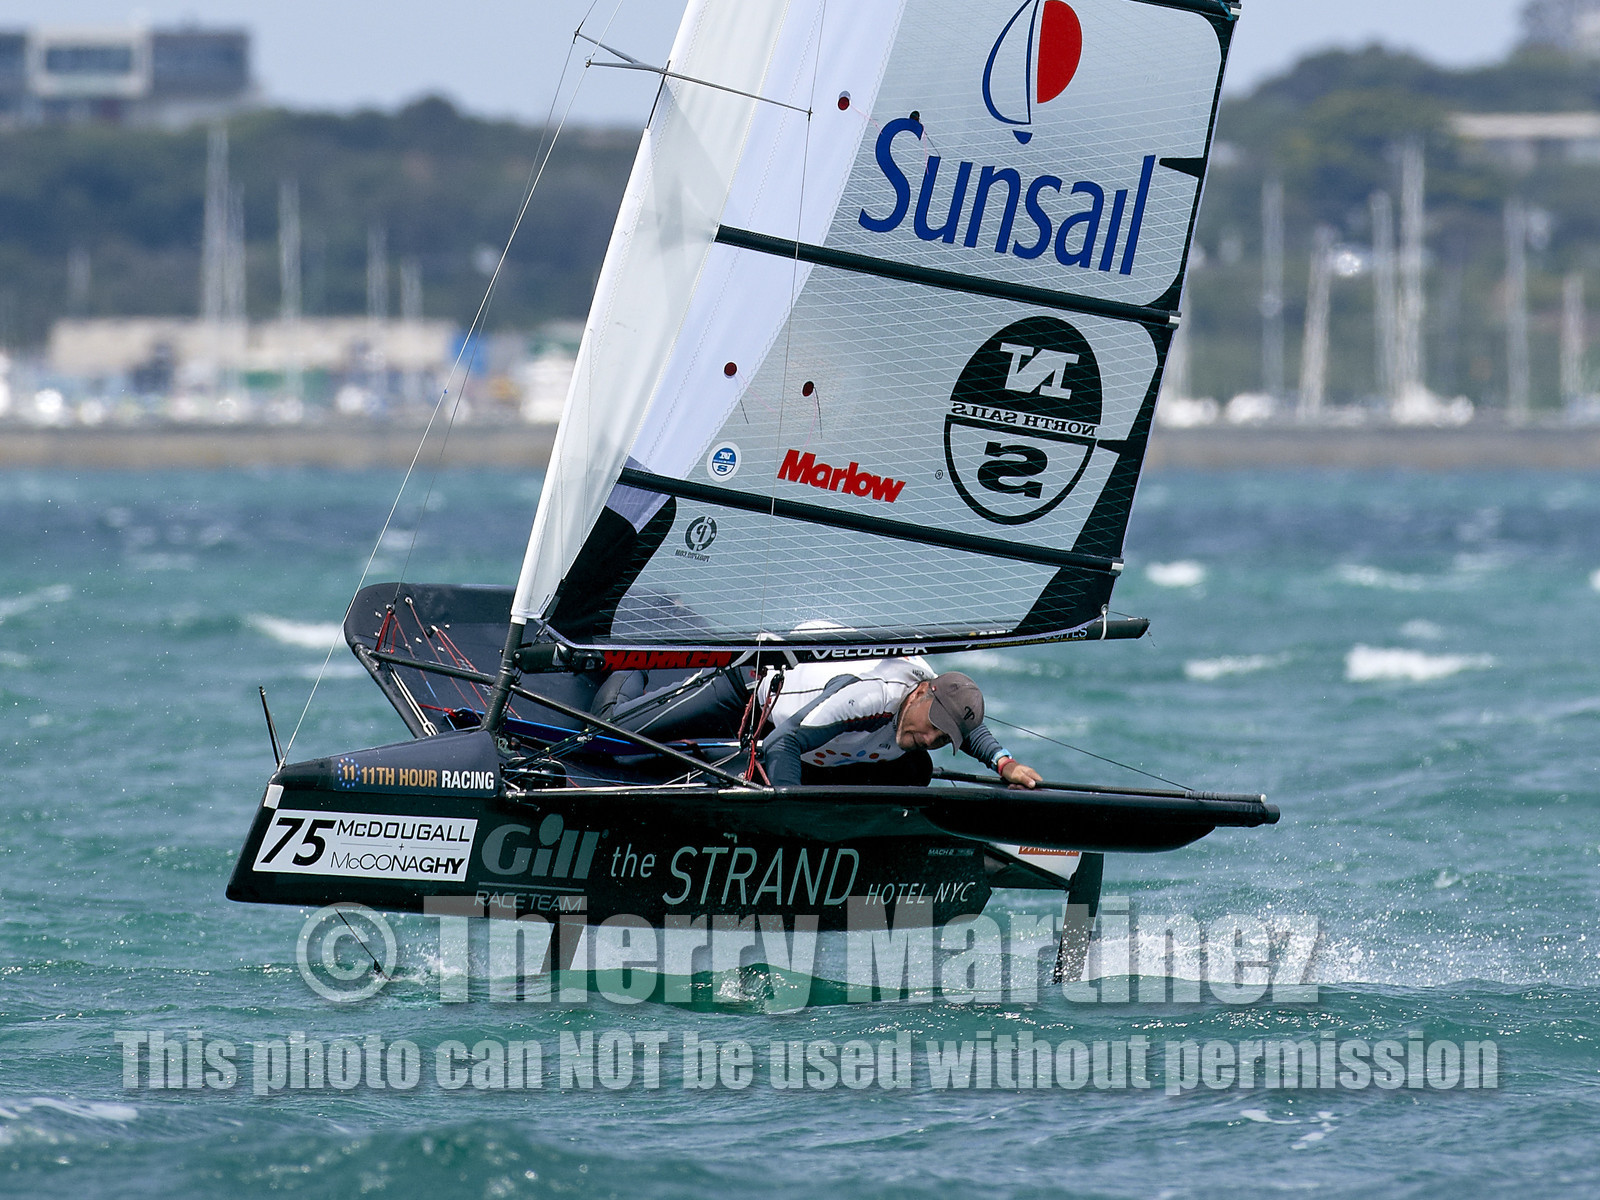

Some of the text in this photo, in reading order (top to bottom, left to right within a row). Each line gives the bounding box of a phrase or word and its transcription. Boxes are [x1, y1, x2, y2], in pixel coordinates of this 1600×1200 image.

[858, 118, 1156, 276] Sunsail
[777, 448, 906, 503] Marlow
[361, 766, 495, 790] 11TH HOUR RACING
[260, 817, 336, 866] 75
[481, 813, 600, 879] Gill
[610, 844, 976, 906] the STRAND HOTEL NYC
